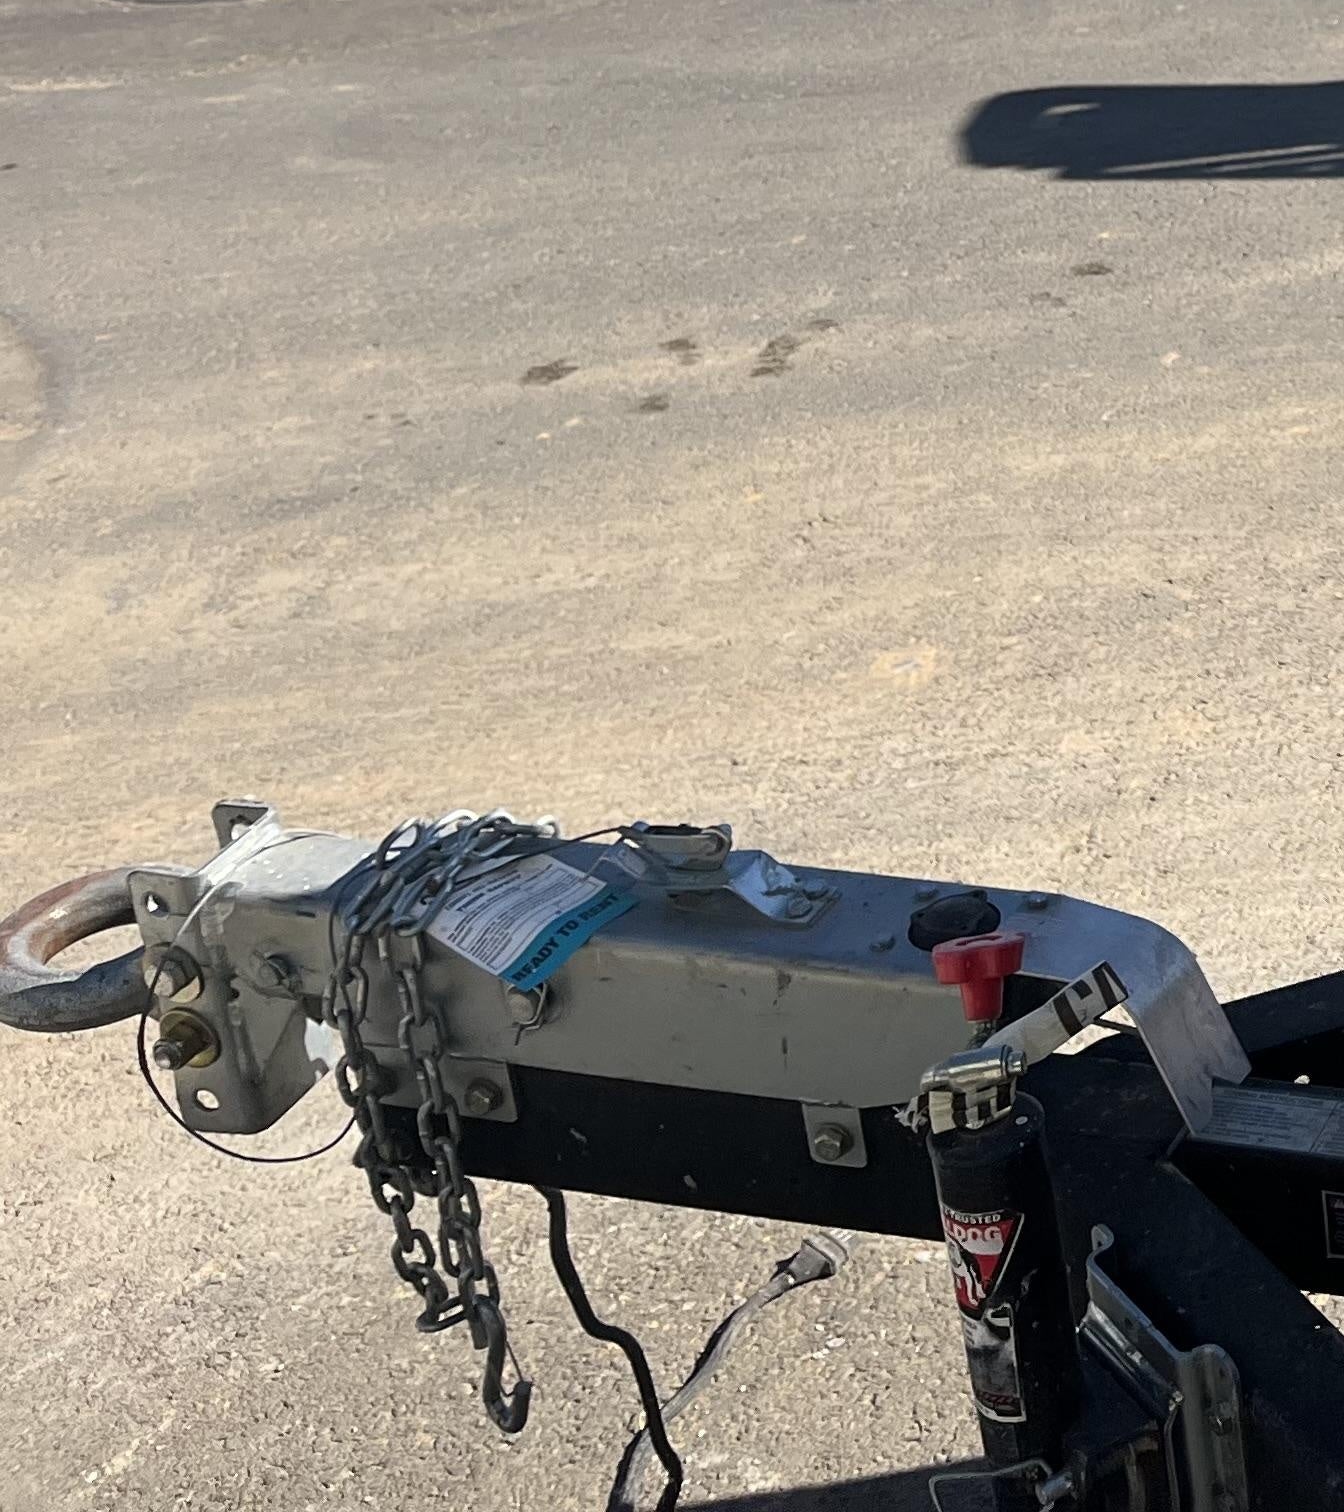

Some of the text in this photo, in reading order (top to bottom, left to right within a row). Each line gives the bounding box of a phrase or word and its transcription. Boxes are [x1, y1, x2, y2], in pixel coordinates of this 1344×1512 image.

[510, 893, 619, 981] READY TO RENT
